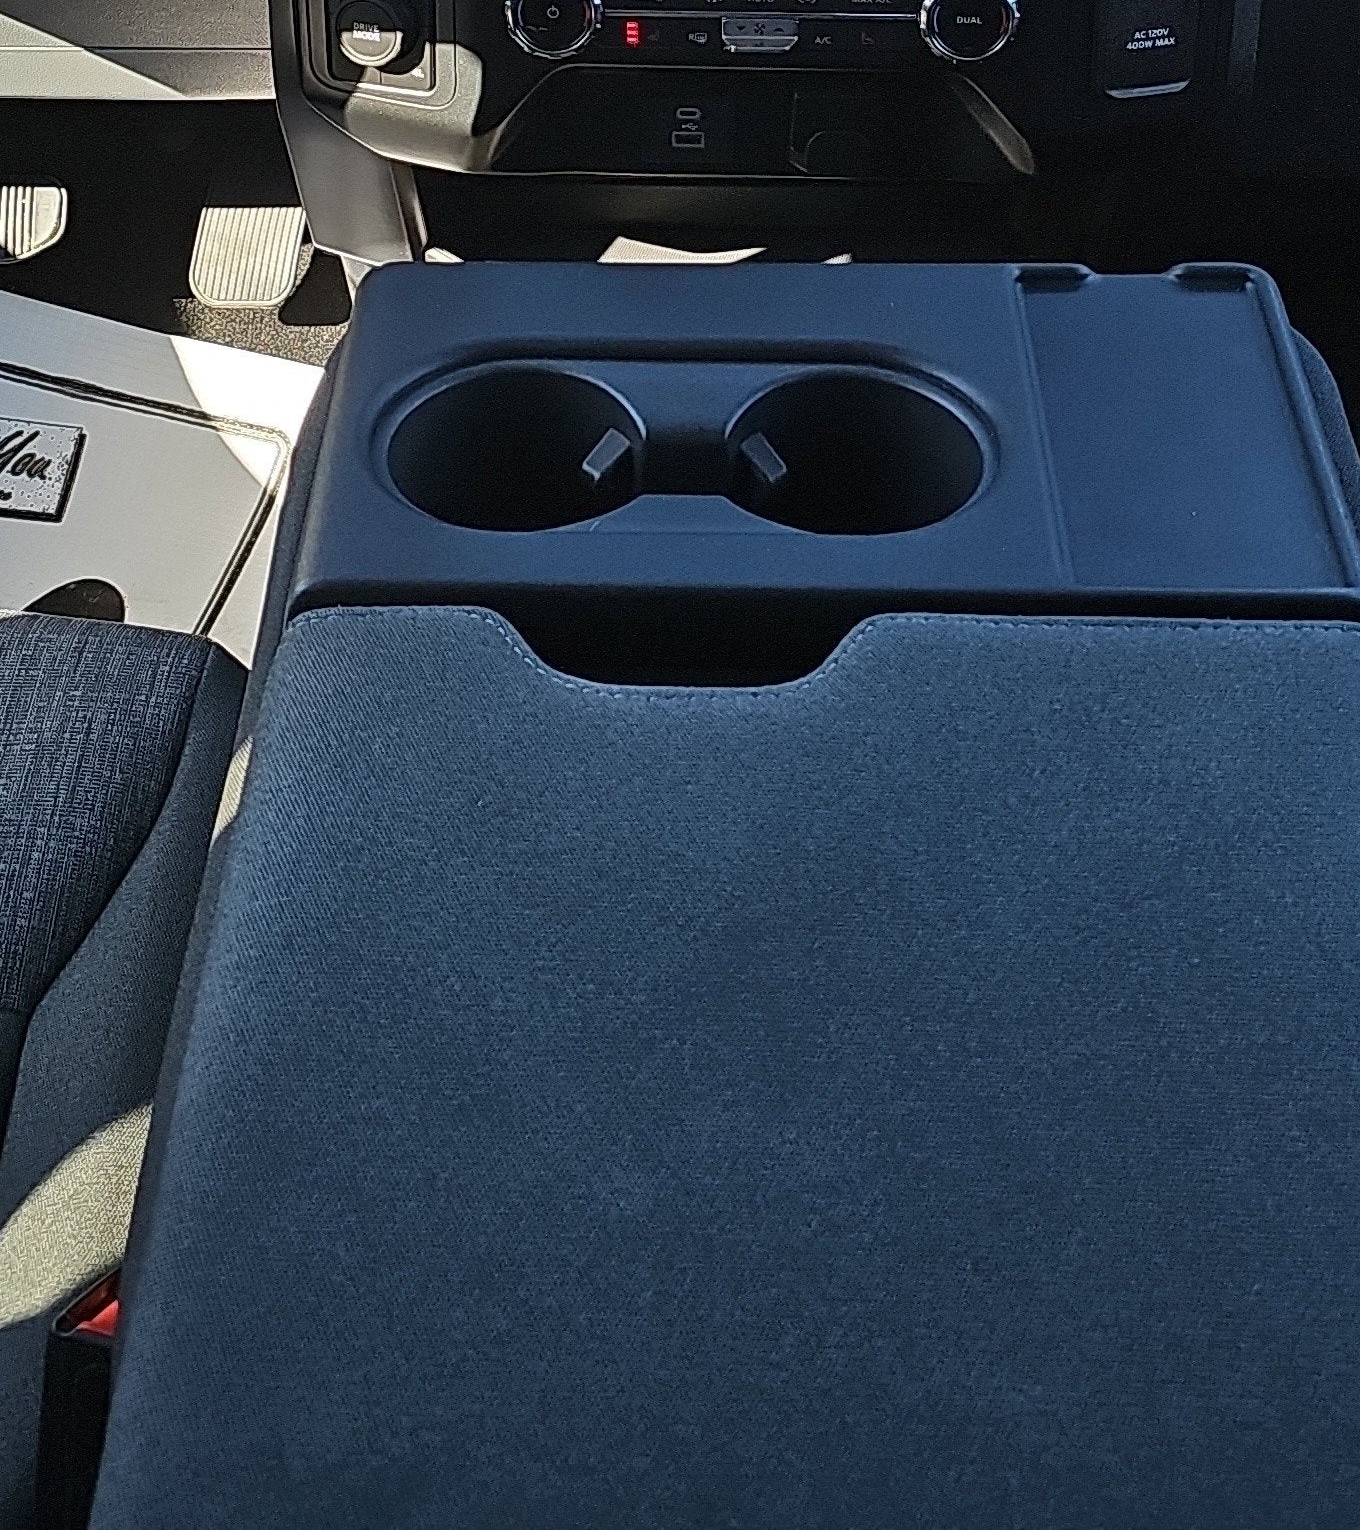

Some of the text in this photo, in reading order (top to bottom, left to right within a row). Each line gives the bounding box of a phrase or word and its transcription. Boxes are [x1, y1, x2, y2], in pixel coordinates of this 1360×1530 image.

[956, 16, 982, 25] DUAL
[354, 22, 380, 32] DRIVE
[1134, 28, 1170, 40] AC 120V
[814, 36, 832, 45] A/C
[1126, 36, 1176, 50] 400W MAX
